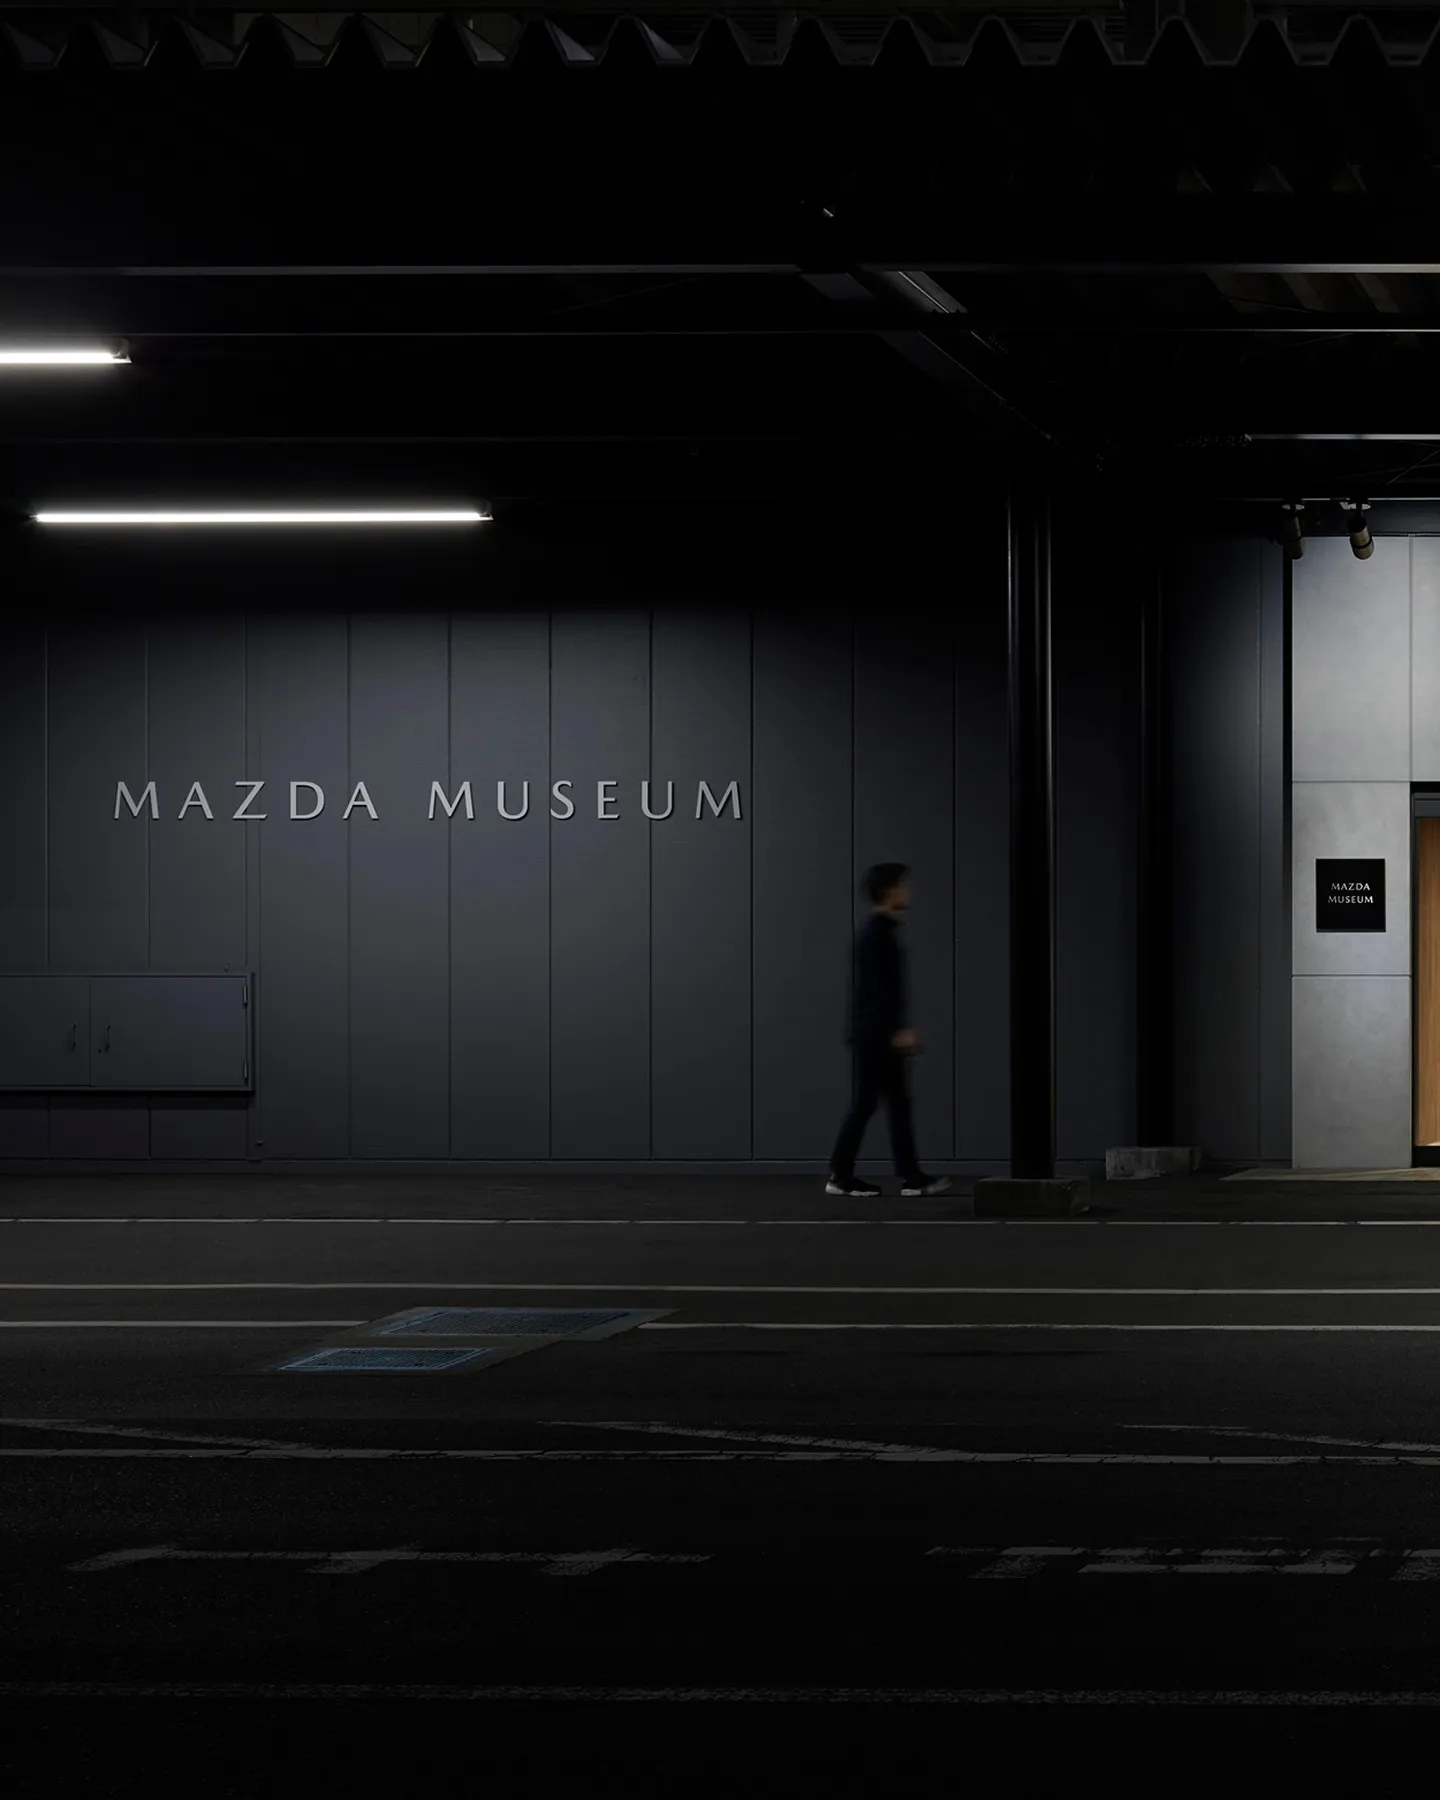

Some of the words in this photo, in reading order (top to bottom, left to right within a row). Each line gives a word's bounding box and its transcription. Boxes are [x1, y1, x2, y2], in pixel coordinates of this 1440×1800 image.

[114, 781, 379, 820] MAZDA
[428, 780, 742, 821] MUSEUM
[1331, 882, 1370, 891] MAZDA
[1327, 895, 1374, 904] MUSEUM
